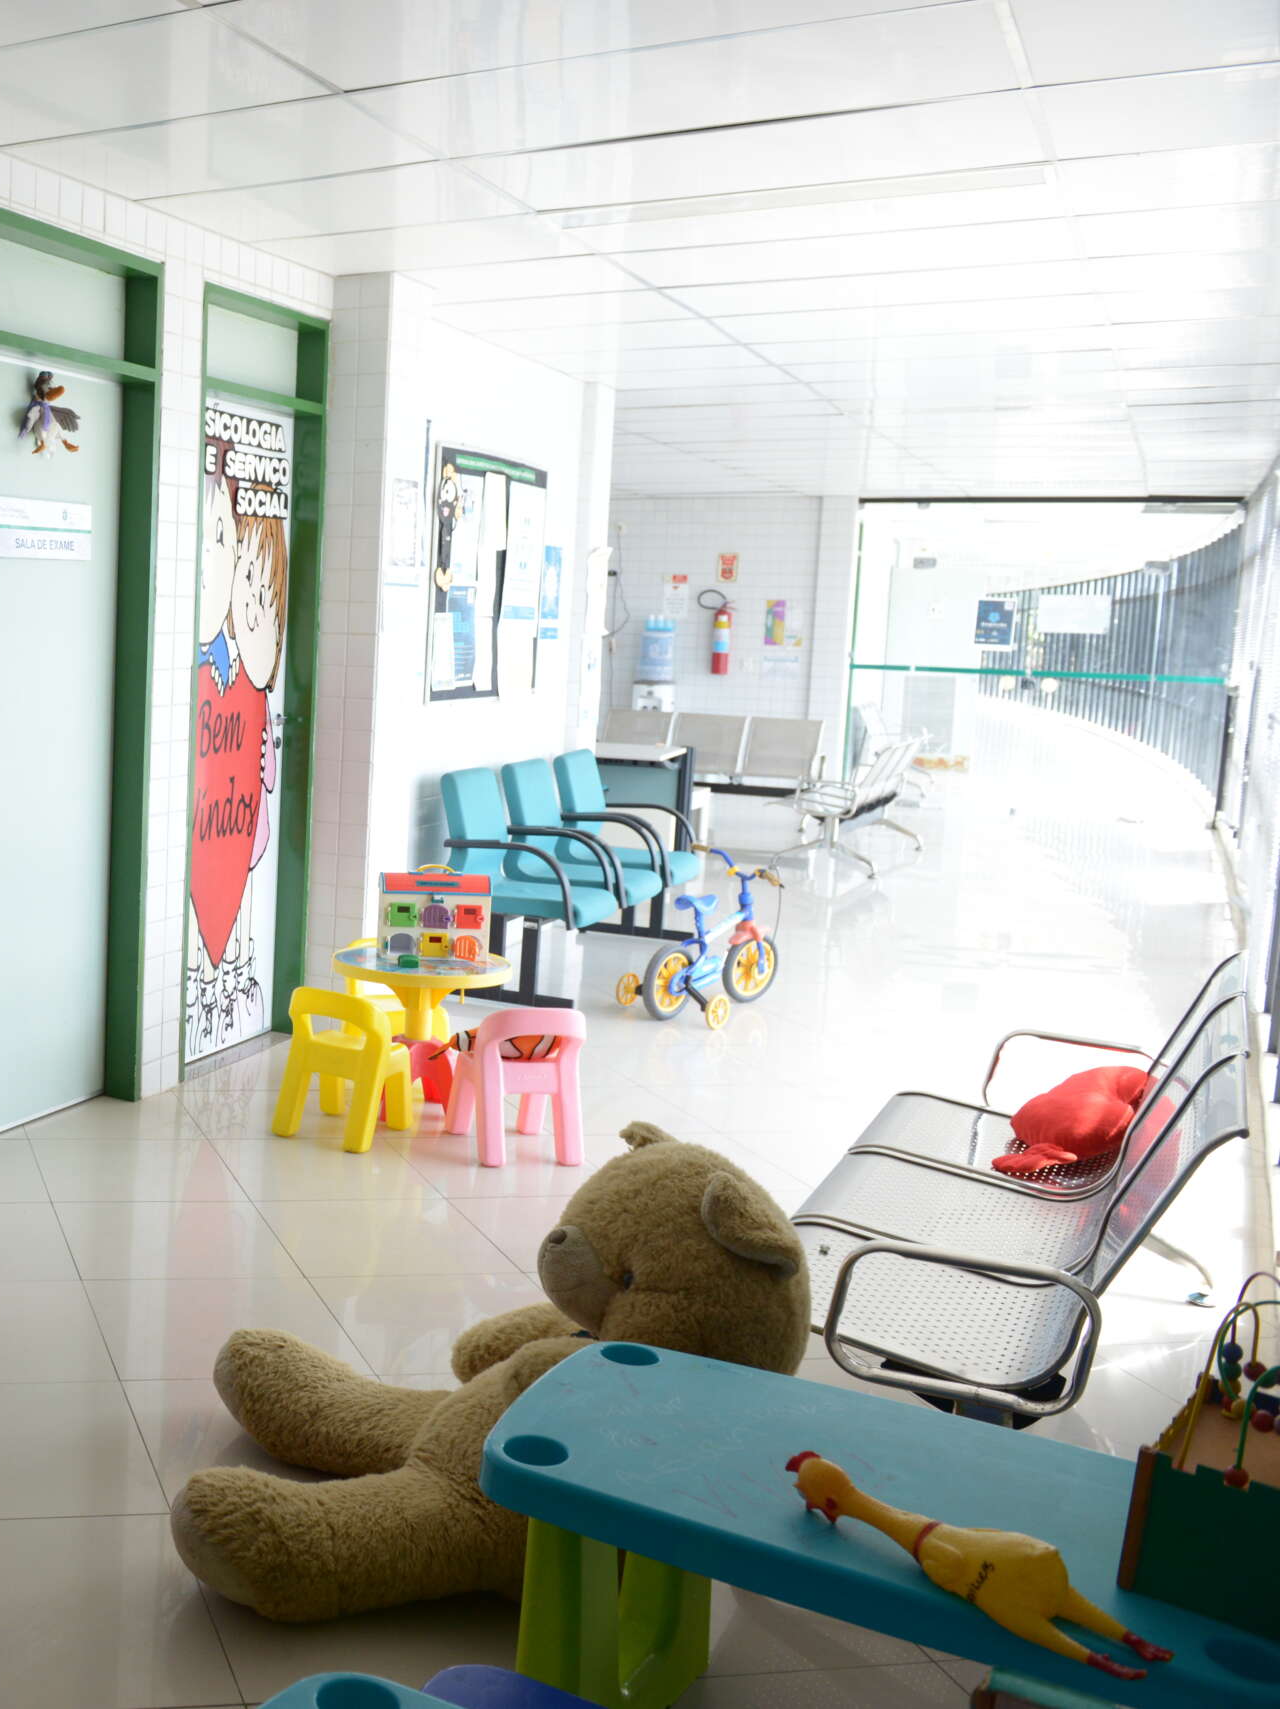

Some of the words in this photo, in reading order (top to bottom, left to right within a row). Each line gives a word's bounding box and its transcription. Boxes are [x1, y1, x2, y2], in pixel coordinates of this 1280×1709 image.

[205, 409, 285, 452] SICOLOGIA
[205, 445, 217, 473] E
[225, 450, 289, 488] SERVIÇO
[236, 488, 288, 519] SOCIAL
[15, 537, 35, 550] SALA
[37, 539, 47, 550] DE
[49, 539, 75, 552] EXAME
[199, 699, 246, 758] Bem
